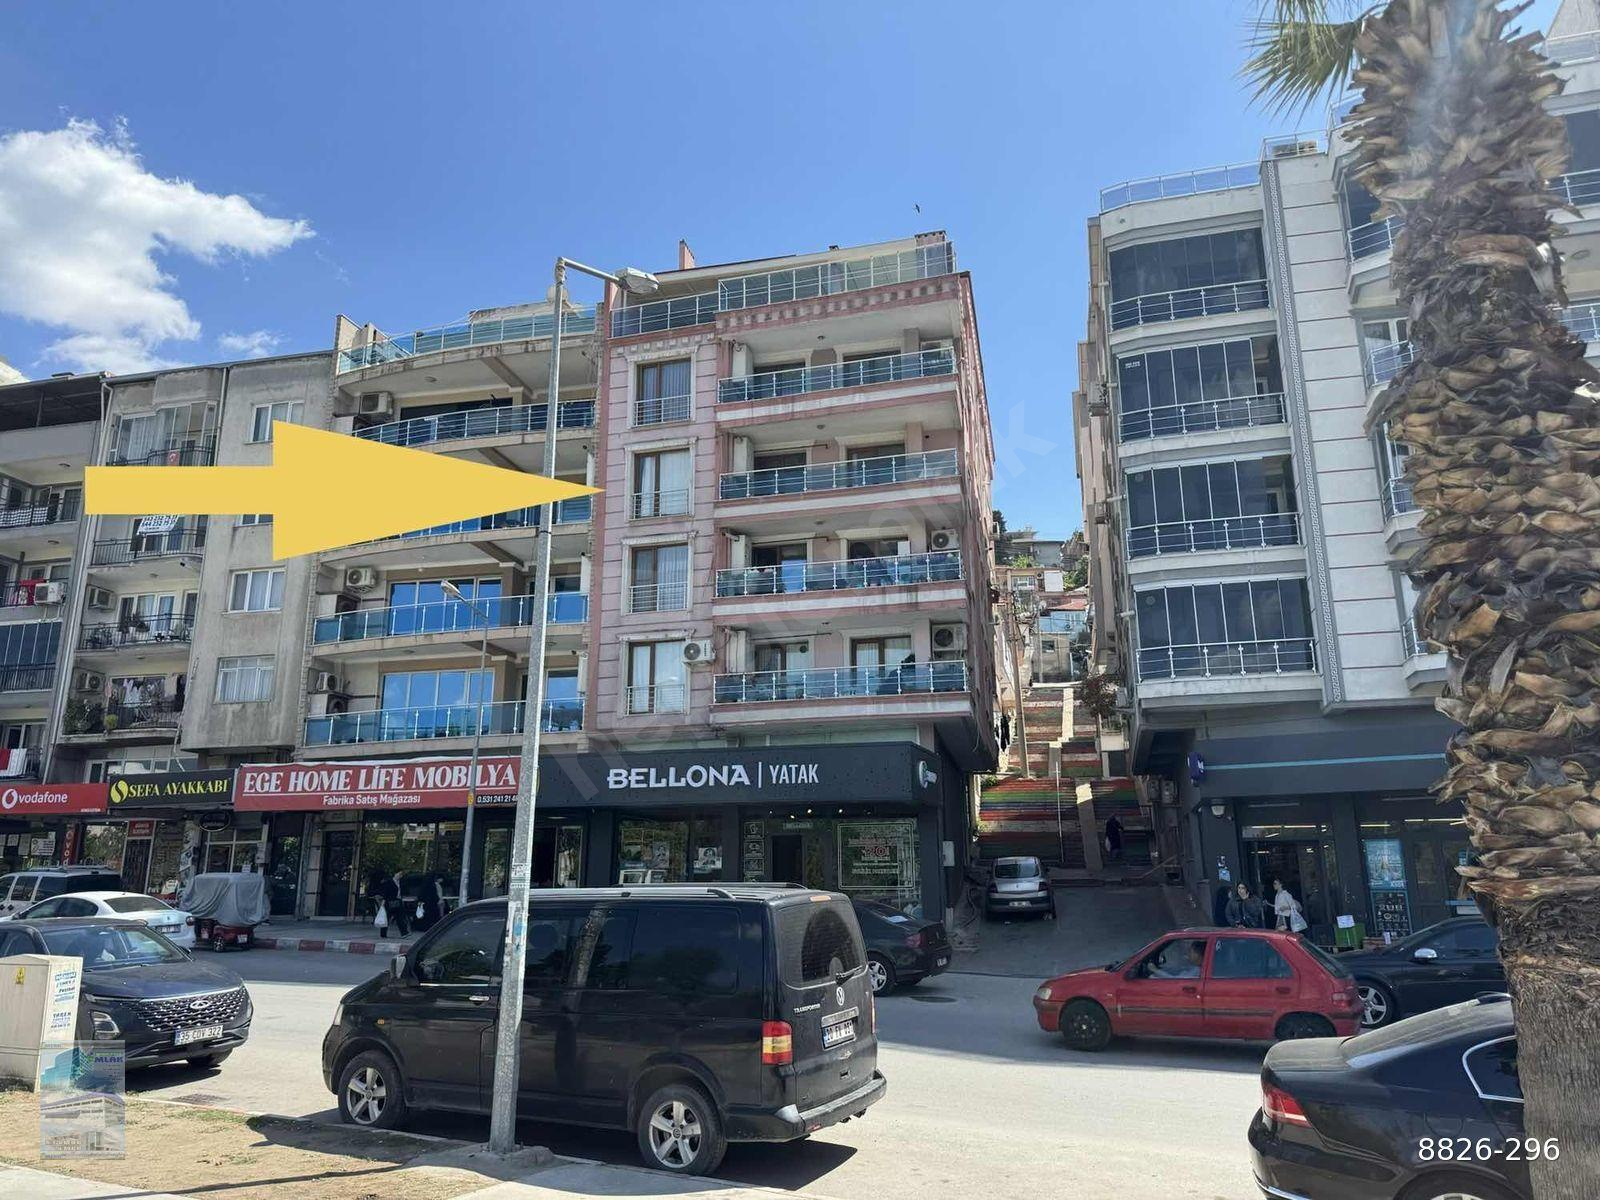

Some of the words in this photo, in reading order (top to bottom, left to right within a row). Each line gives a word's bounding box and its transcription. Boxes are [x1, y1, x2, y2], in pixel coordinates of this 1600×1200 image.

[243, 772, 283, 793] EGE
[288, 769, 353, 792] HOME
[358, 765, 407, 790] LİFE
[607, 764, 751, 789] BELLONA
[769, 763, 820, 785] YATAK
[18, 791, 68, 803] vodafone
[128, 783, 160, 797] SEFA
[162, 778, 229, 796] AYAKKABI
[322, 795, 355, 806] Fabrika
[356, 794, 378, 807] Satış
[379, 793, 420, 807] Mağazası
